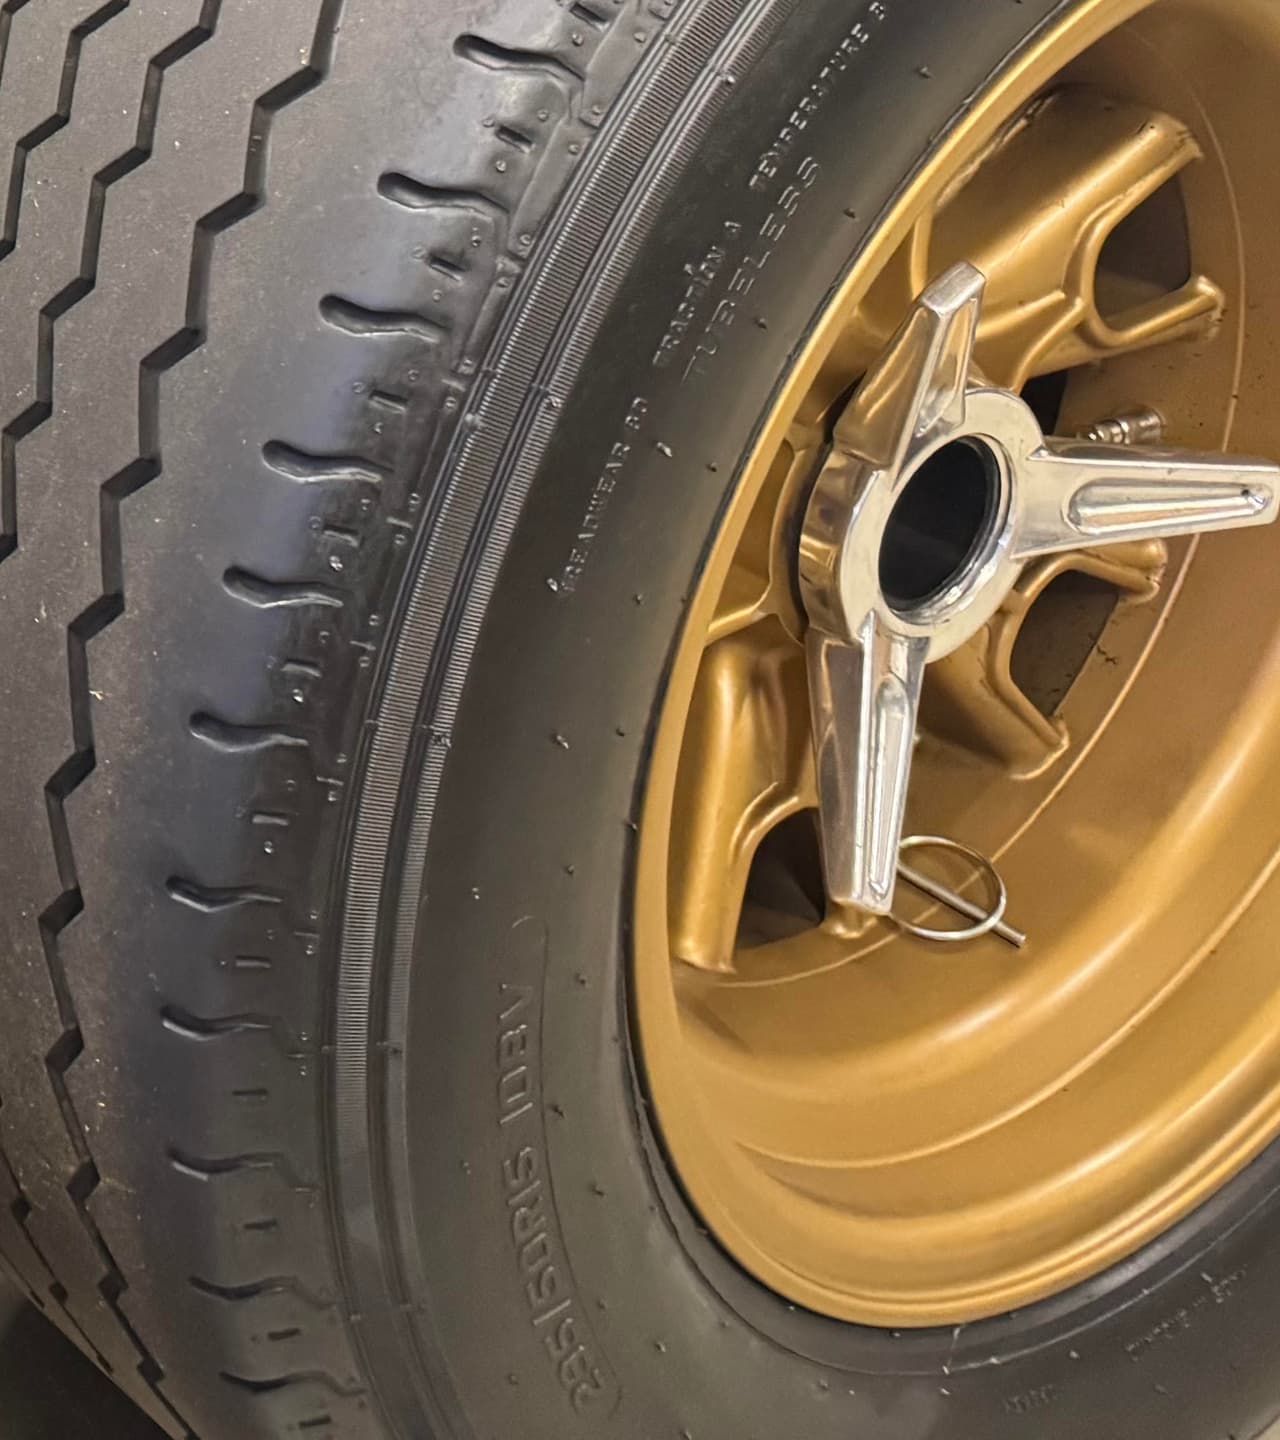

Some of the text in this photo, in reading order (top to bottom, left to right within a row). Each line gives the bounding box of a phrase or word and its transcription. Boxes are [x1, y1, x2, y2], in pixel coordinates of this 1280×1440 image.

[651, 244, 727, 366] TRACTION
[748, 21, 870, 192] TEMPERATURE
[680, 155, 821, 386] TUBELESS
